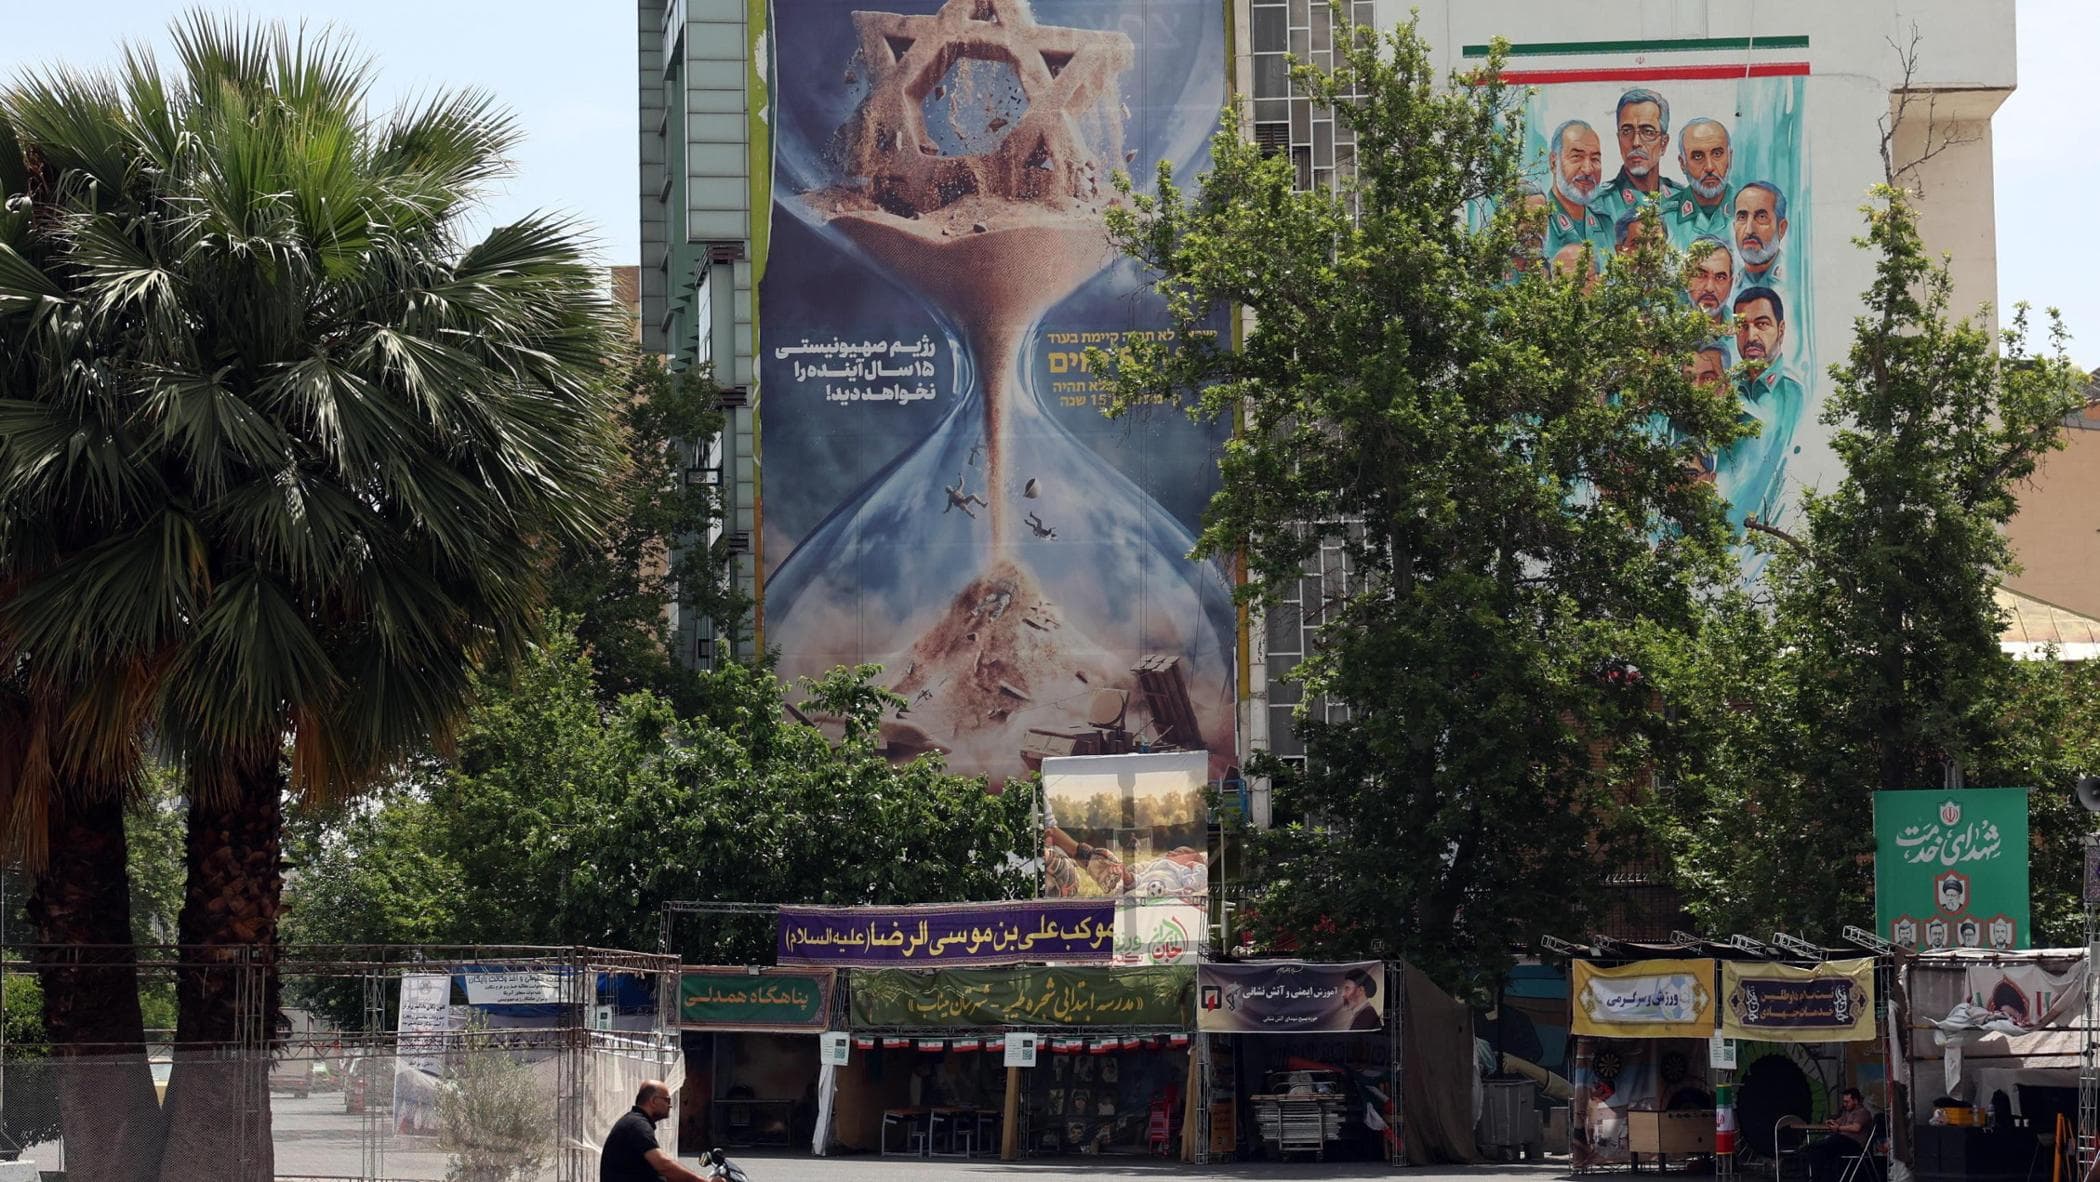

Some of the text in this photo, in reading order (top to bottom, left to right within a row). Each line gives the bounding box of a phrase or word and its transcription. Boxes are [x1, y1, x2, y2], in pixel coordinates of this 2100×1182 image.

[775, 334, 936, 359] رژیم صهیونیستی
[1047, 332, 1079, 345] בעוד
[1157, 328, 1175, 341] לא
[794, 358, 935, 382] ۱۵ سال آینده را
[826, 382, 937, 406] نخواهد دید!
[870, 920, 928, 957] الرضا
[929, 925, 993, 957] موسی
[993, 921, 1019, 951] بن
[1018, 914, 1059, 950] علی
[1060, 917, 1114, 951] موکب
[684, 985, 809, 1010] پناهگاه همدلی
[1242, 985, 1339, 999] آموزش ایمنی و آتش نشانی
[1606, 991, 1647, 1008] سرگرمی
[1652, 991, 1679, 1007] ورزش
